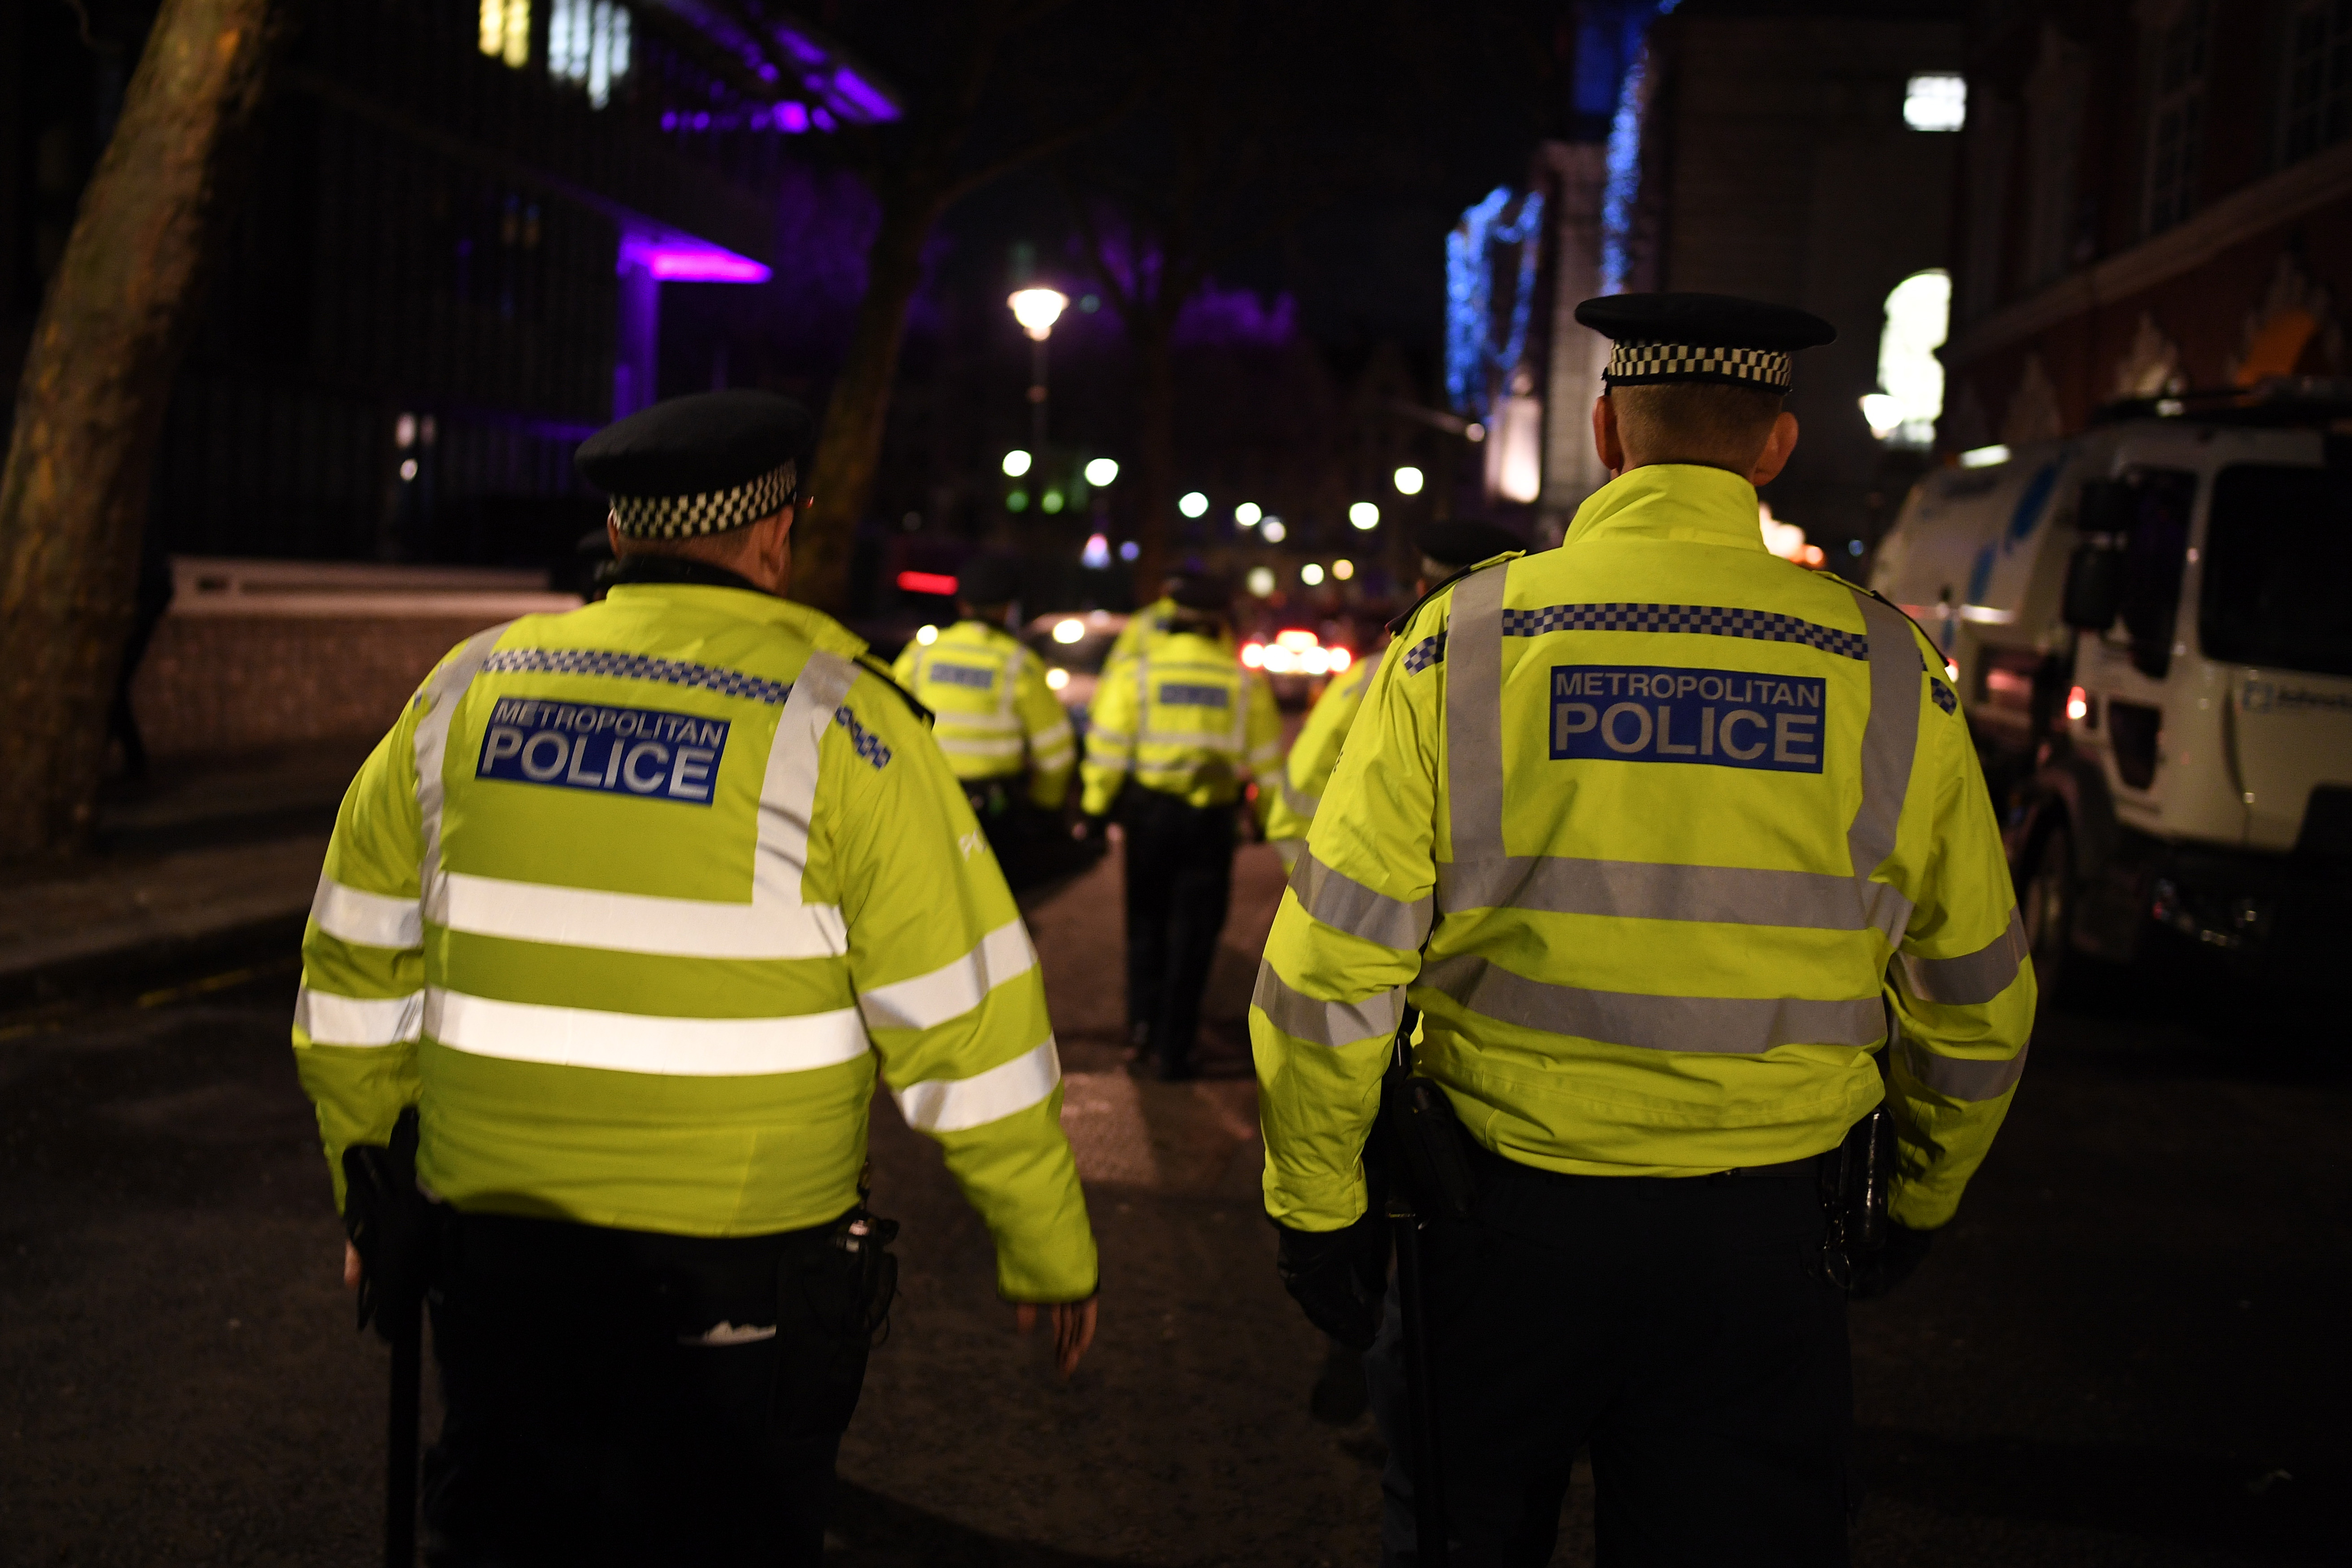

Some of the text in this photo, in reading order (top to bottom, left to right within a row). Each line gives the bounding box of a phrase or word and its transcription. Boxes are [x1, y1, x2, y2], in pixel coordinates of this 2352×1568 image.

[1556, 672, 1819, 707] METROPOLITAN
[494, 700, 723, 748] METROPOLITAN
[1555, 702, 1818, 764] POLICE
[482, 727, 715, 800] POLICE
